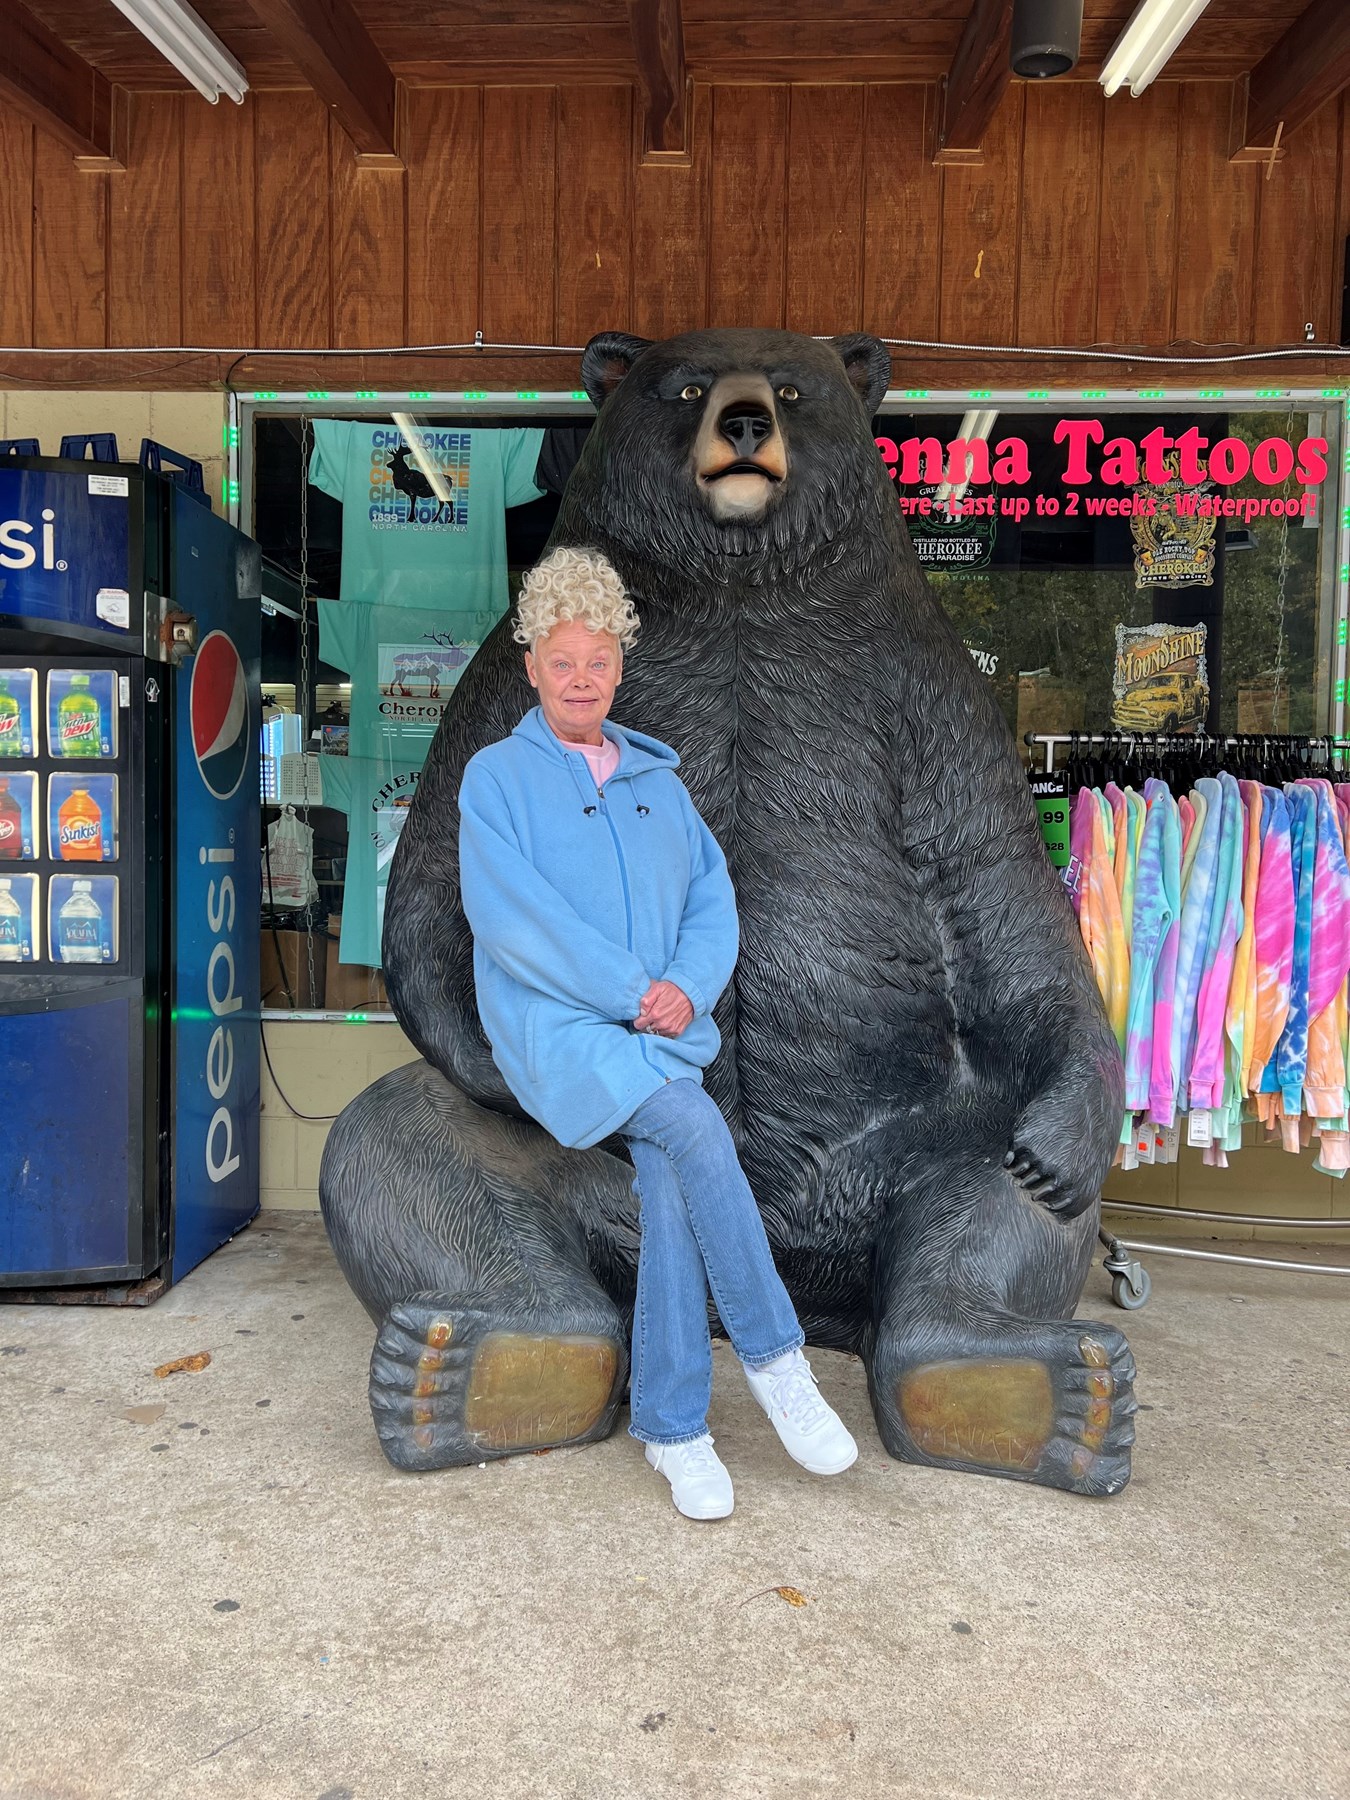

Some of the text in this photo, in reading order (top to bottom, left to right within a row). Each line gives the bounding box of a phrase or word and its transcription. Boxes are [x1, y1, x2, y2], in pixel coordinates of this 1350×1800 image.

[1053, 419, 1328, 486] Tattoos
[372, 513, 398, 522] 1839
[950, 493, 996, 516] Last
[1001, 495, 1031, 523] up
[1036, 494, 1060, 516] to
[1065, 492, 1080, 516] 2
[1086, 493, 1156, 516] weeks
[1176, 493, 1317, 523] Waterproof!
[1141, 562, 1207, 575] CHEROKEE
[968, 647, 999, 675] TNS
[1043, 811, 1064, 824] 99
[60, 821, 99, 844] Sunkist
[199, 847, 243, 1183] pepsi
